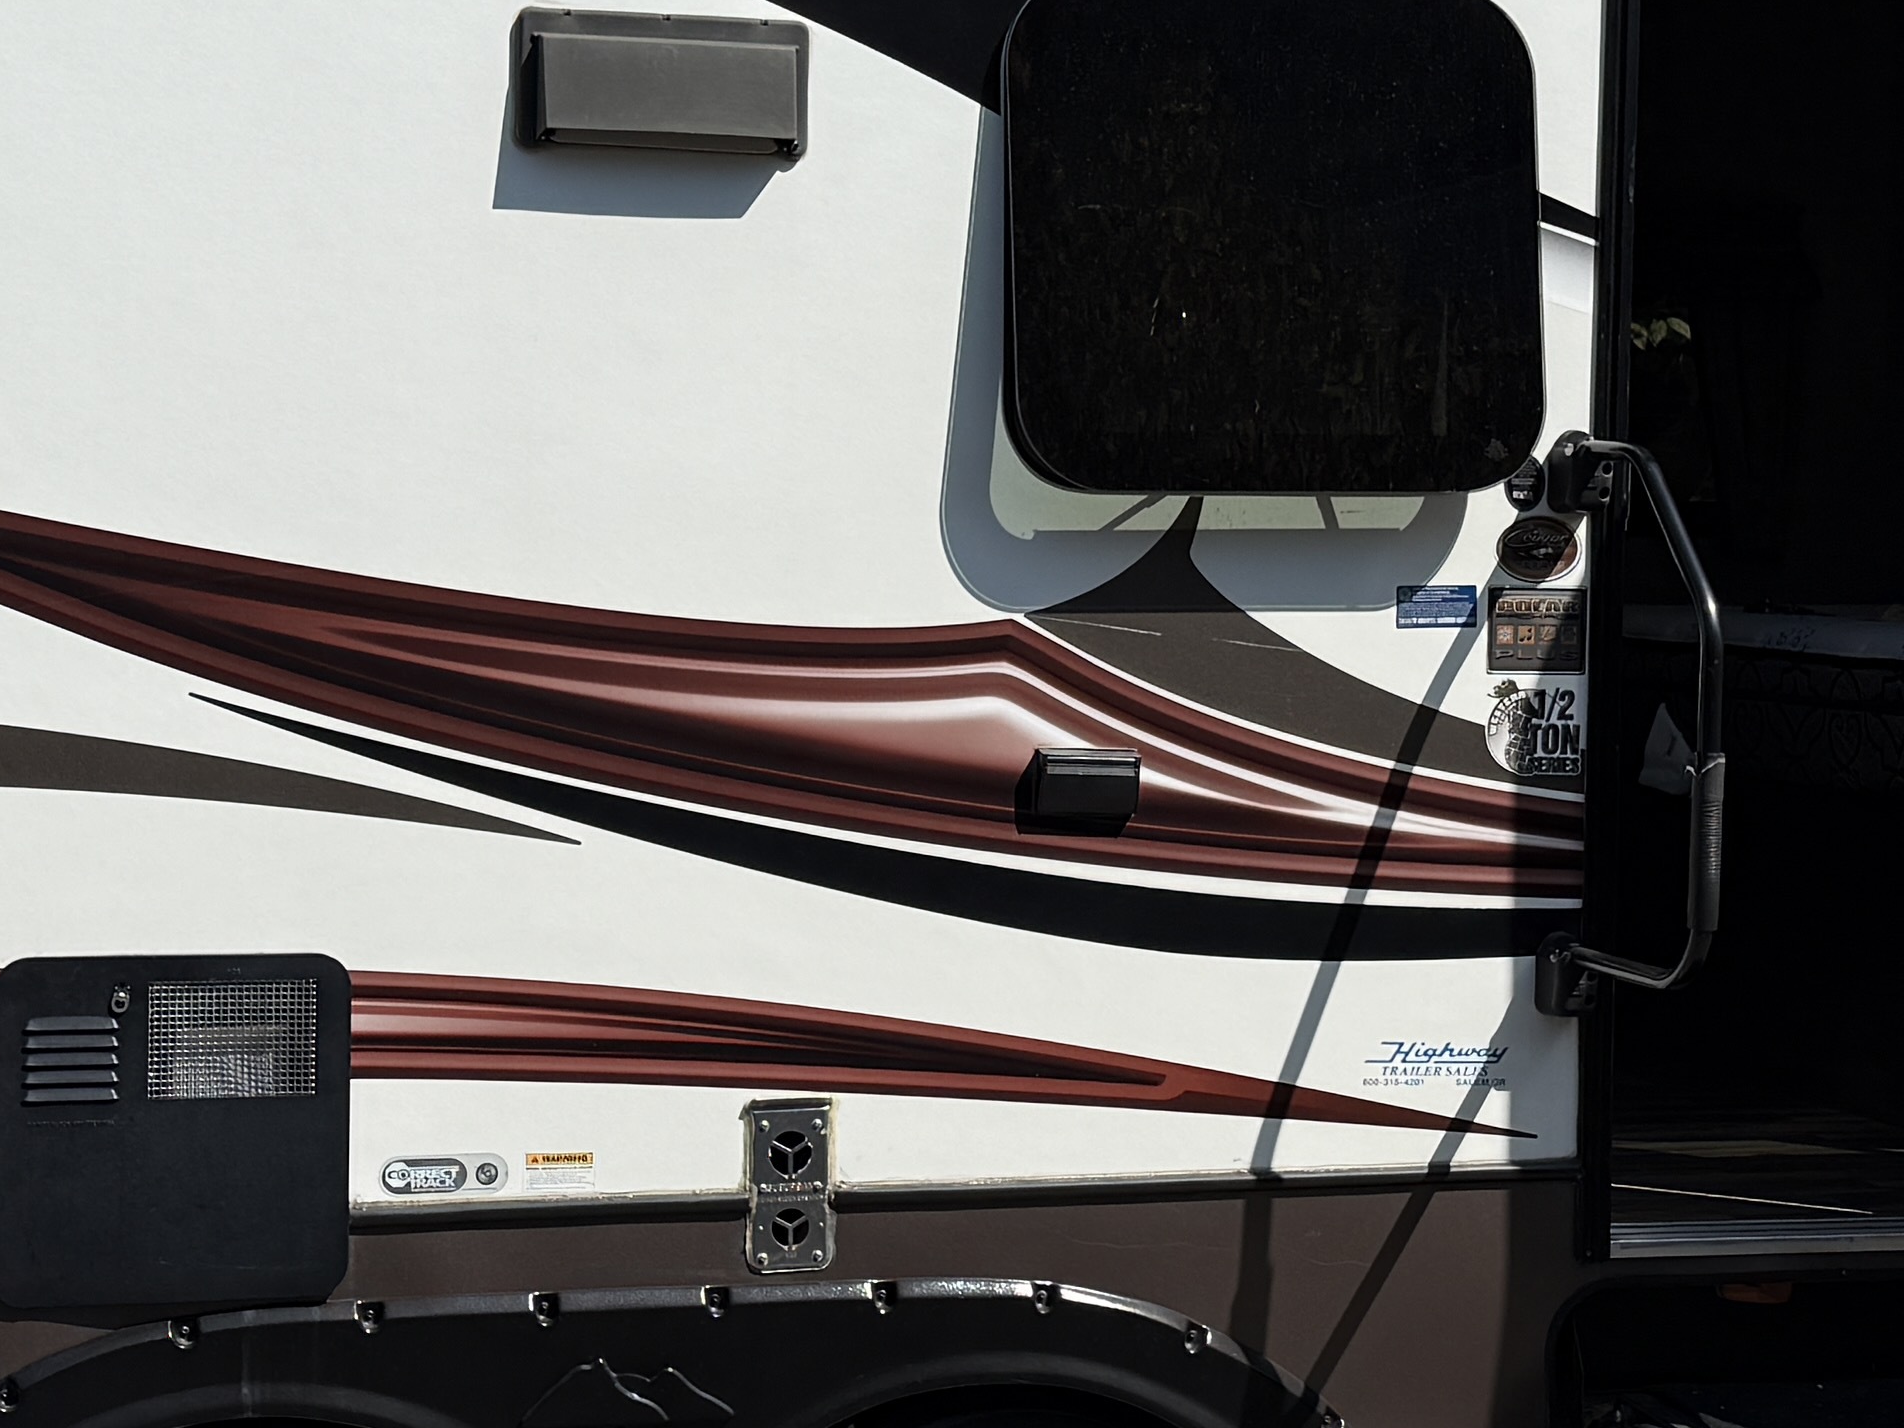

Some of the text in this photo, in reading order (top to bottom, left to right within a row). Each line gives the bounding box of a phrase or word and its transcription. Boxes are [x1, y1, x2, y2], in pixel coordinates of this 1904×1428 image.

[1533, 687, 1575, 722] 1/2
[1530, 723, 1581, 756] TON
[1365, 1041, 1509, 1063] Highway
[1382, 1066, 1442, 1077] TRAILER
